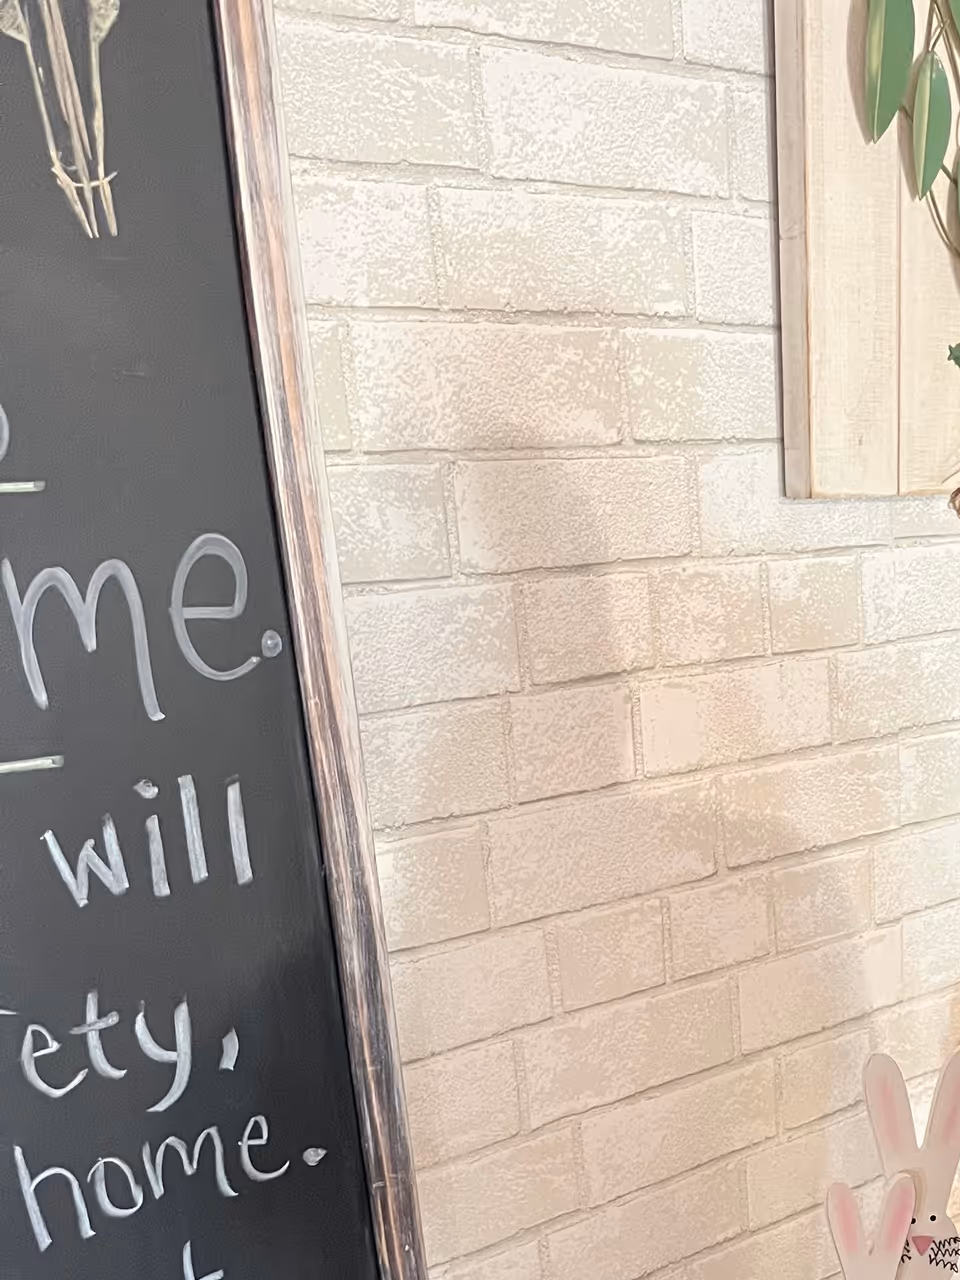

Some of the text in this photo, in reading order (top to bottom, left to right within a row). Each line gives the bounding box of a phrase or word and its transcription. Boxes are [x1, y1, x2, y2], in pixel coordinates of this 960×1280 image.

[40, 774, 254, 908] will
[0, 990, 239, 1112] ety,
[13, 1114, 329, 1252] home.
